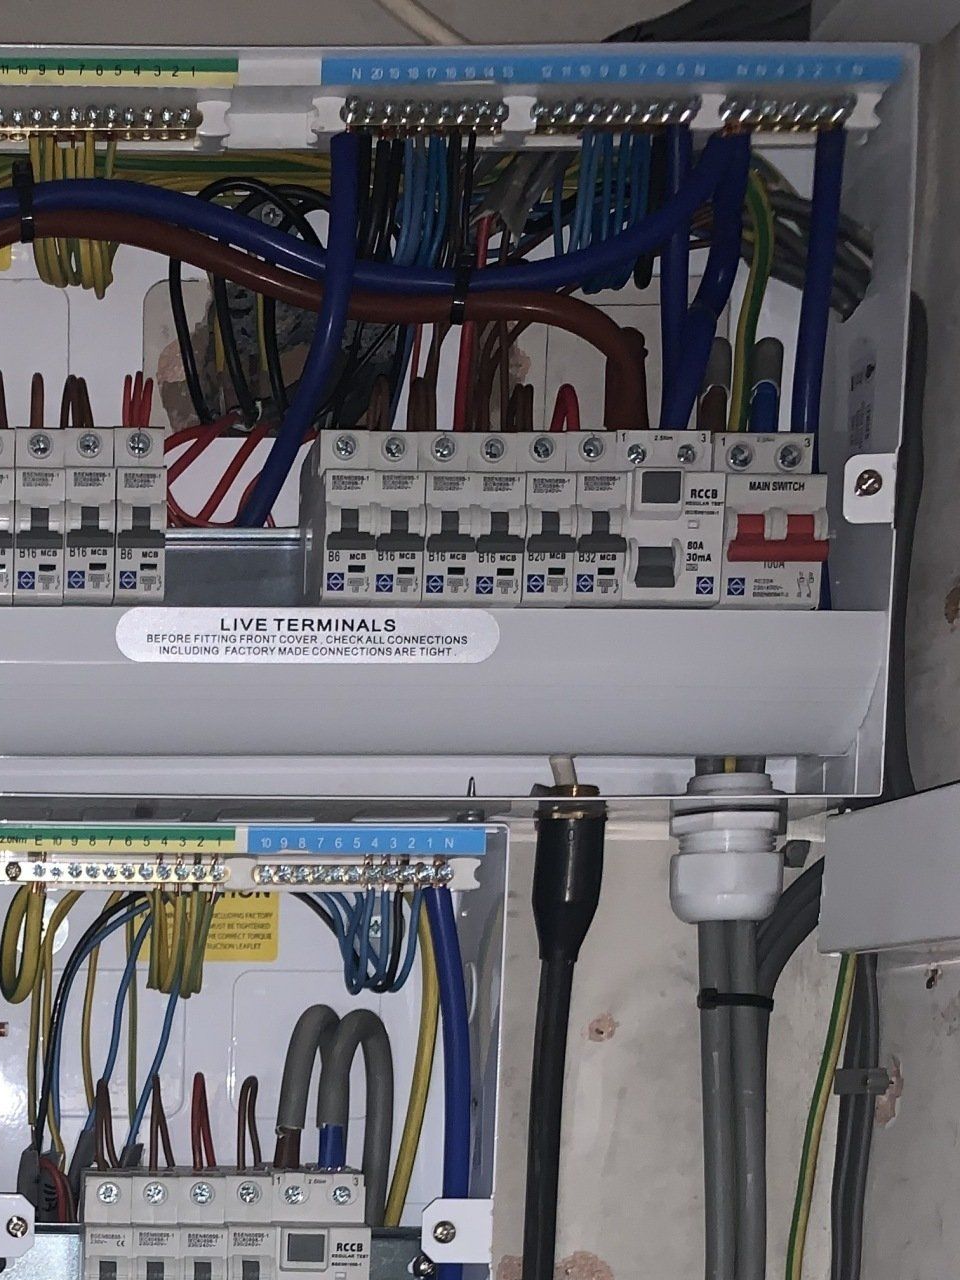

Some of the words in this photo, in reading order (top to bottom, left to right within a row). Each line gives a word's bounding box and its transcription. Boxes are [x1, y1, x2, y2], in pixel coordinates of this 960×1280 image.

[1, 64, 8, 74] 11
[18, 64, 28, 74] 10
[38, 64, 45, 75] 9
[58, 64, 64, 75] 8
[79, 65, 85, 75] 7
[96, 65, 103, 76] 6
[115, 65, 121, 76] 5
[134, 65, 140, 76] 4
[154, 66, 161, 76] 3
[172, 66, 178, 77] 2
[192, 66, 195, 76] 1
[352, 68, 361, 79] N
[371, 68, 383, 80] 20
[427, 67, 437, 78] 17
[749, 481, 770, 491] MAIN
[772, 481, 805, 491] SWITCH
[690, 489, 717, 499] RCCB
[19, 548, 36, 558] B16
[70, 547, 86, 557] B16
[121, 548, 132, 559] B6
[328, 551, 340, 562] B6
[378, 552, 395, 561] B16
[429, 552, 445, 562] B16
[478, 553, 495, 563] B16
[579, 553, 595, 563] B32
[686, 553, 711, 562] 30mA
[220, 618, 267, 632] LIVE
[273, 619, 396, 632] TERMINALS
[147, 634, 191, 643] BEFORE
[194, 634, 236, 644] FITTING
[240, 635, 276, 644] FRONT
[326, 636, 366, 644] CHECK
[366, 636, 384, 644] ALL
[387, 636, 468, 644] CONNECTIONS
[160, 646, 219, 655] INCLUDING
[225, 647, 274, 655] FACTORY
[278, 647, 309, 656] MADE
[312, 647, 392, 656] CONNECTIONS
[394, 647, 416, 656] ARE
[0, 836, 27, 844] 2.0Nm
[35, 836, 42, 846] E
[53, 837, 62, 846] 10
[72, 837, 78, 846] 9
[89, 836, 96, 846] 8
[107, 836, 113, 846] 7
[125, 836, 132, 846] 6
[144, 836, 150, 846] 5
[161, 836, 168, 846] 4
[180, 837, 185, 847] 3
[197, 837, 204, 847] 2
[217, 837, 220, 846] 1
[261, 838, 271, 848] 10
[281, 838, 287, 848] 9
[299, 838, 306, 848] 8
[318, 838, 324, 848] 7
[335, 838, 342, 848] 6
[354, 838, 360, 848] 5
[371, 838, 378, 848] 4
[390, 838, 396, 848] 3
[408, 838, 415, 848] 2
[427, 838, 432, 848] 1
[445, 838, 454, 848] N
[337, 1243, 363, 1252] RCCB
